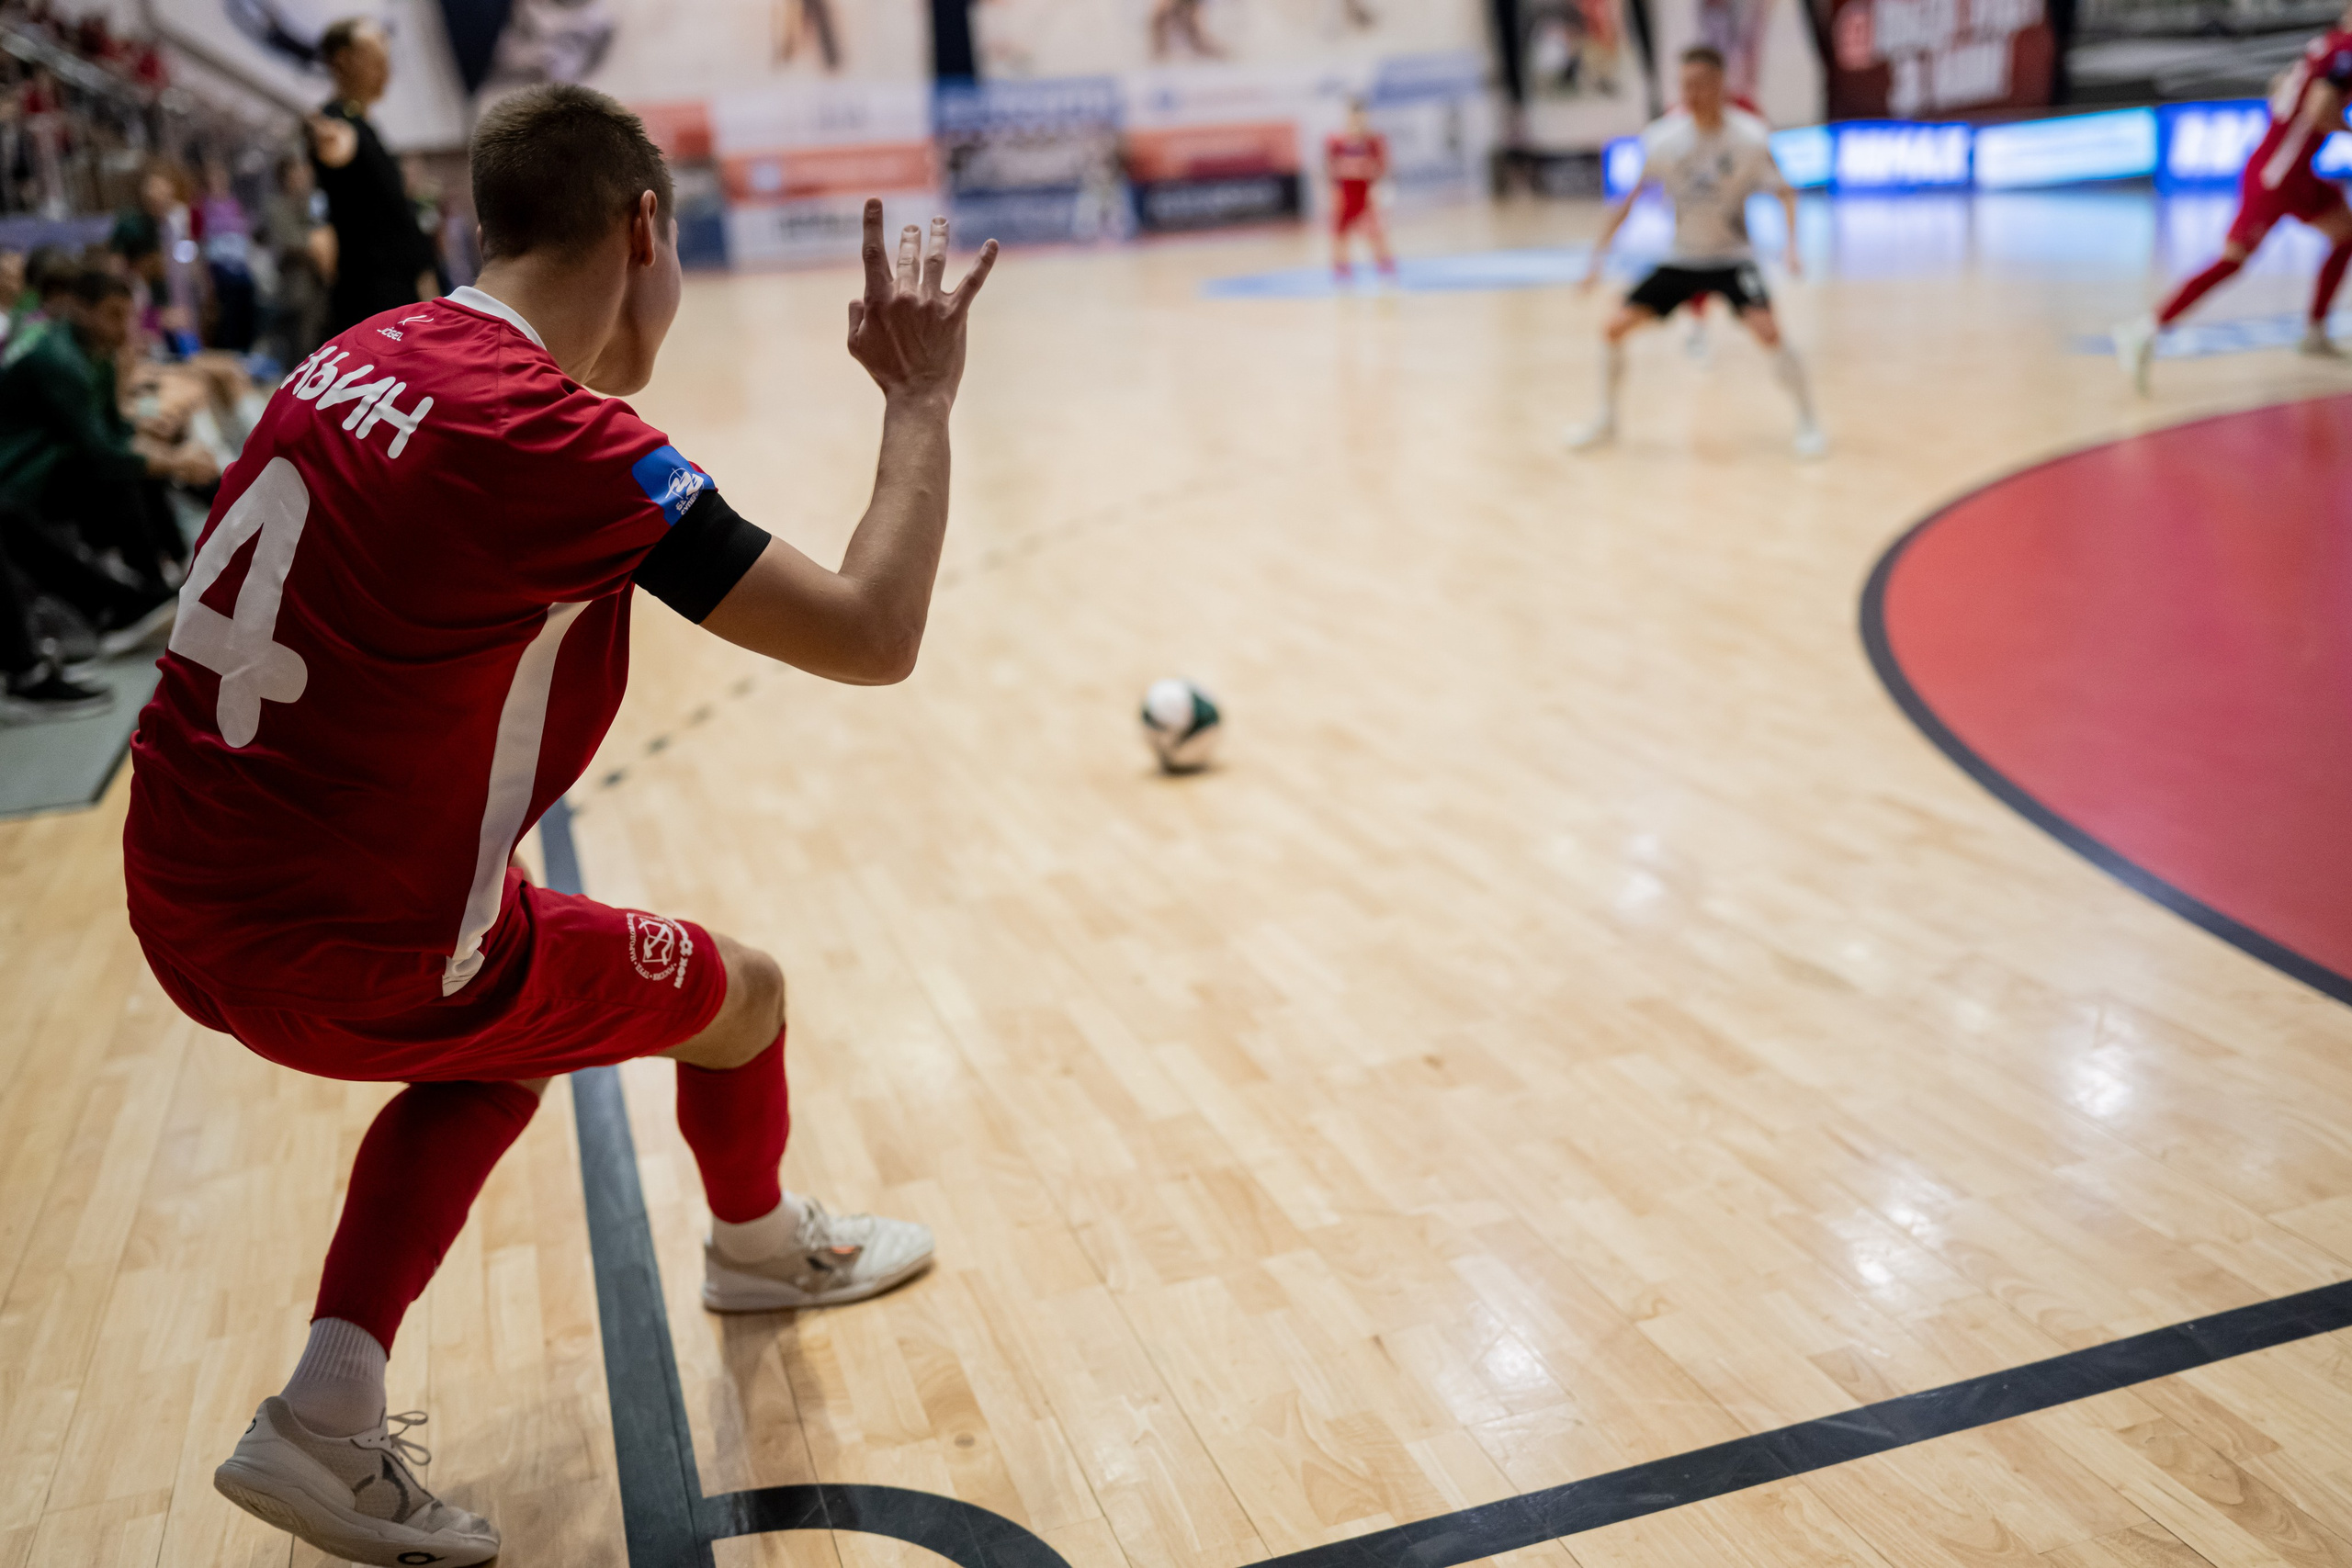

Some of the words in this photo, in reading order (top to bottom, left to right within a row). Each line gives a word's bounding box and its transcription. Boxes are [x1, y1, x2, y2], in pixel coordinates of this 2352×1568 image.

[280, 345, 434, 459] ЛЬИН
[681, 491, 699, 515] СУПЕР
[168, 456, 311, 749] 4
